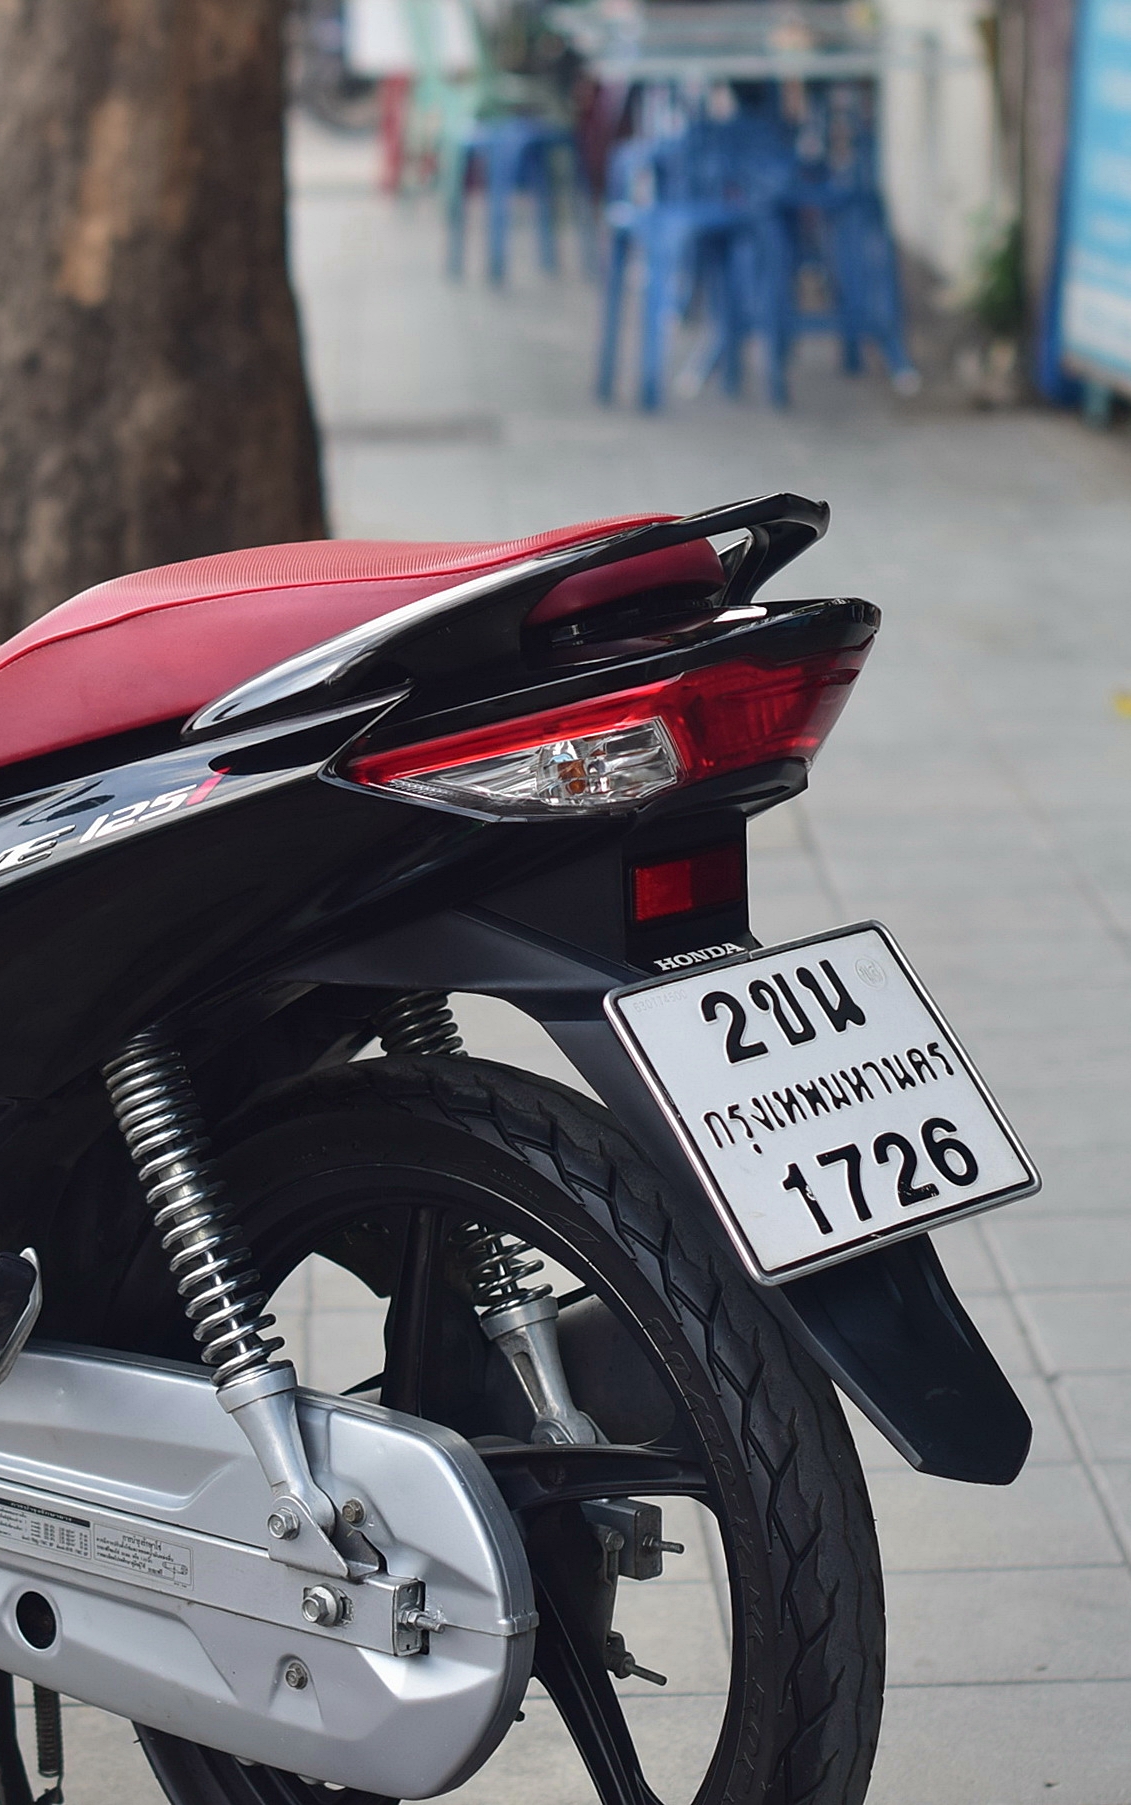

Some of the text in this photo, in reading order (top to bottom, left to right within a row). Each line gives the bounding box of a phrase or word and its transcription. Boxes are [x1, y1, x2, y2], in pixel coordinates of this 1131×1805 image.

[79, 766, 232, 845] 125i
[653, 941, 746, 972] HONDA
[700, 959, 867, 1064] 2ขน
[703, 1042, 955, 1155] กรุงเทพมหานคร
[781, 1117, 980, 1236] 1726
